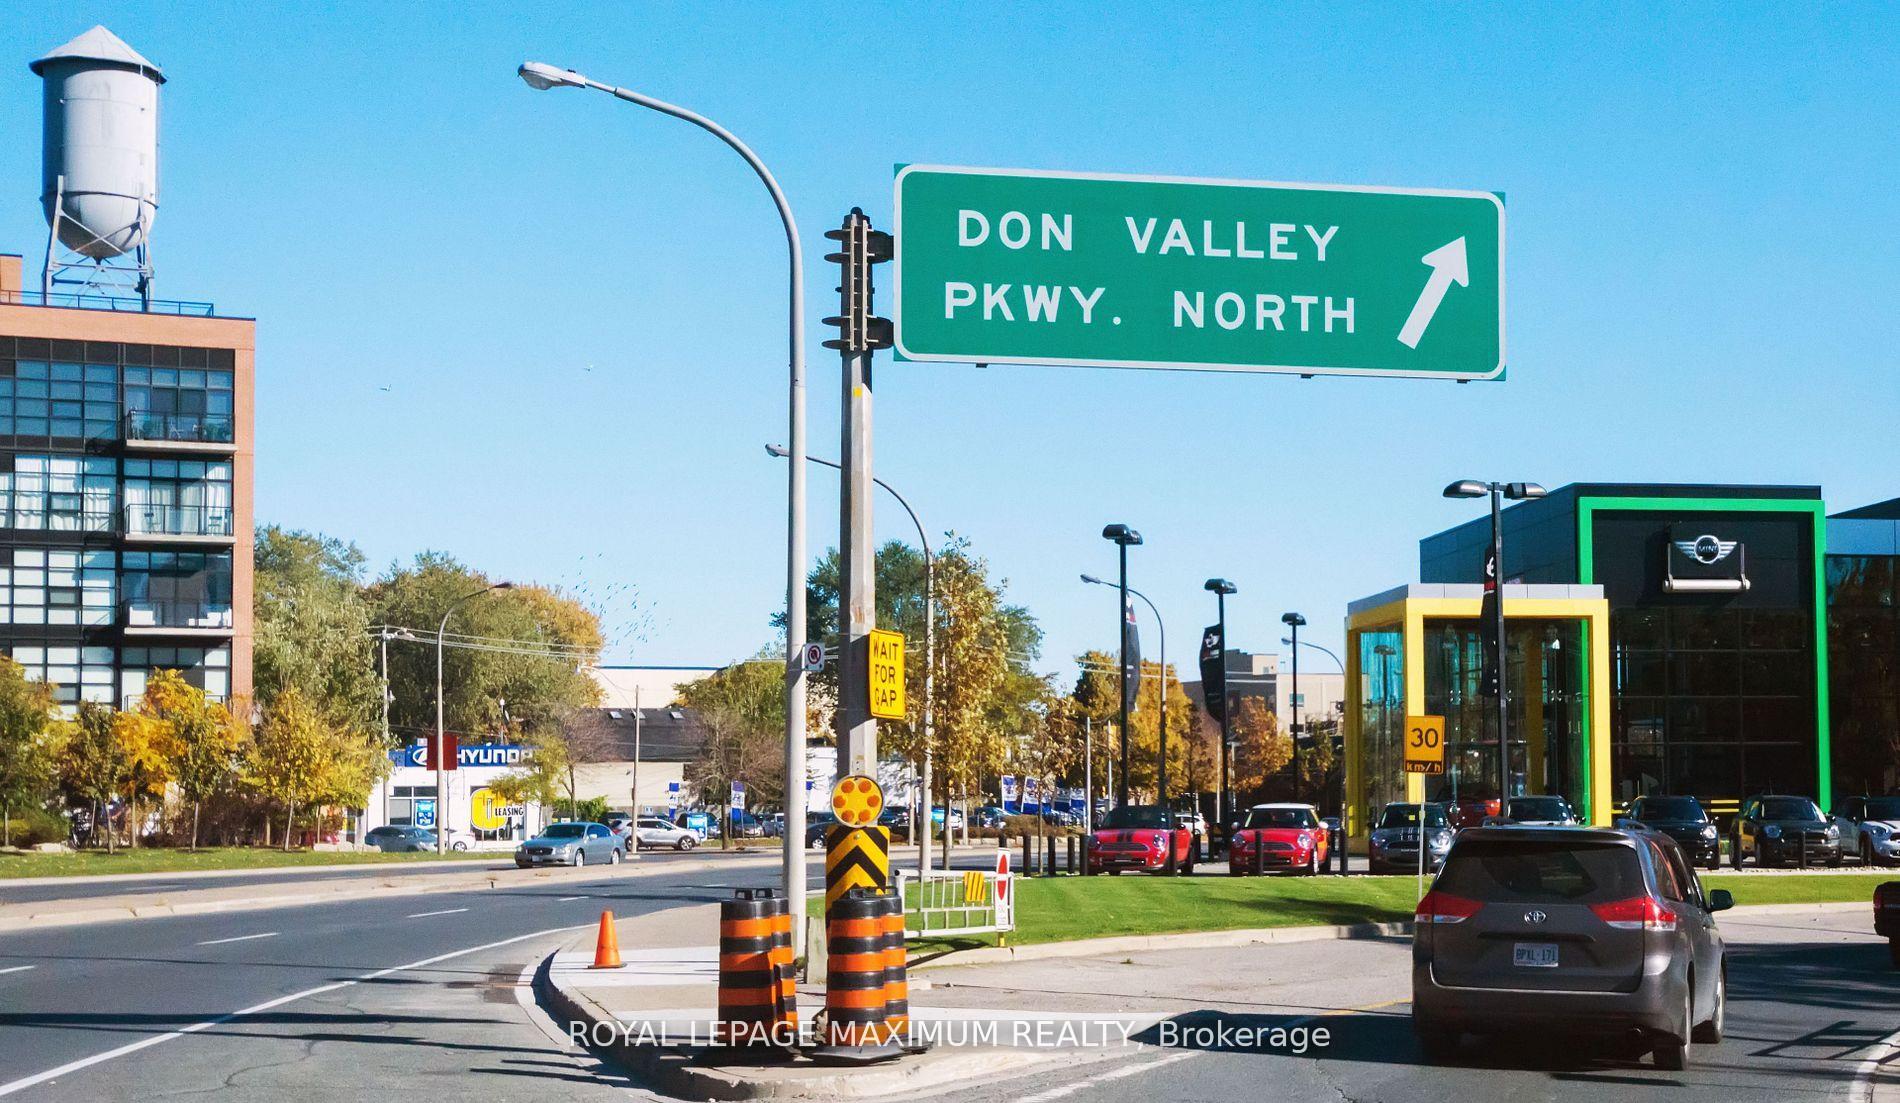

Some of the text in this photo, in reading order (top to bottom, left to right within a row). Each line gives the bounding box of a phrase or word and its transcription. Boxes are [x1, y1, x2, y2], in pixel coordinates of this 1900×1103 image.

[958, 210, 1339, 262] DON VALLEY
[945, 282, 1355, 333] PKWY. NORTH
[873, 637, 899, 660] WAIT
[875, 664, 896, 684] FOR
[875, 687, 897, 707] GAP
[1411, 727, 1439, 748] 30
[1406, 762, 1441, 772] km/h
[494, 807, 524, 817] LEASING
